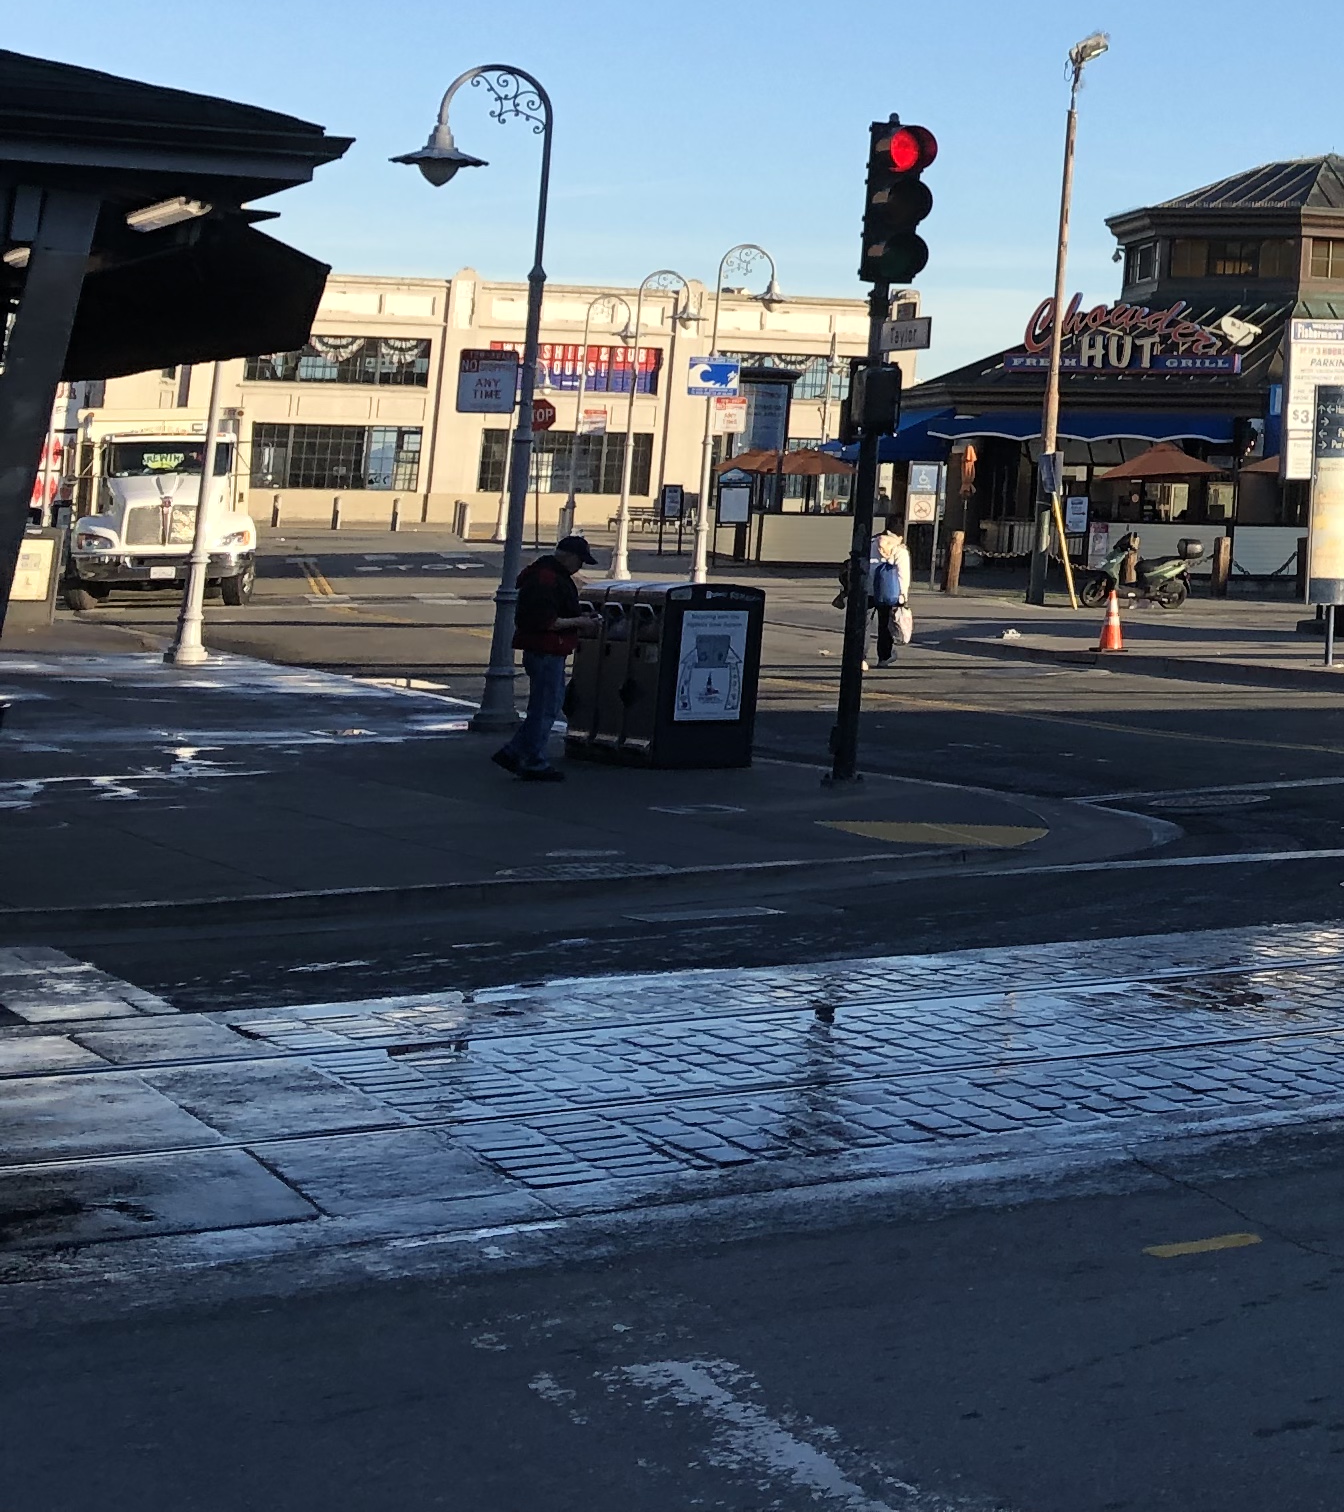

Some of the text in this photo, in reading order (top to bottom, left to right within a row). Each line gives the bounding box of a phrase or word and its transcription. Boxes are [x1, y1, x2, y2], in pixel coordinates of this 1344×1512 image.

[1024, 291, 1217, 354] Chowder
[890, 327, 918, 348] Taylor
[543, 344, 585, 361] SHIP
[616, 347, 648, 363] SUB
[1080, 334, 1160, 369] HUT
[461, 359, 478, 372] NO
[1012, 356, 1230, 369] FREH GRILL
[475, 378, 501, 388] ANY
[473, 389, 502, 400] TIME
[531, 408, 555, 423] TOP
